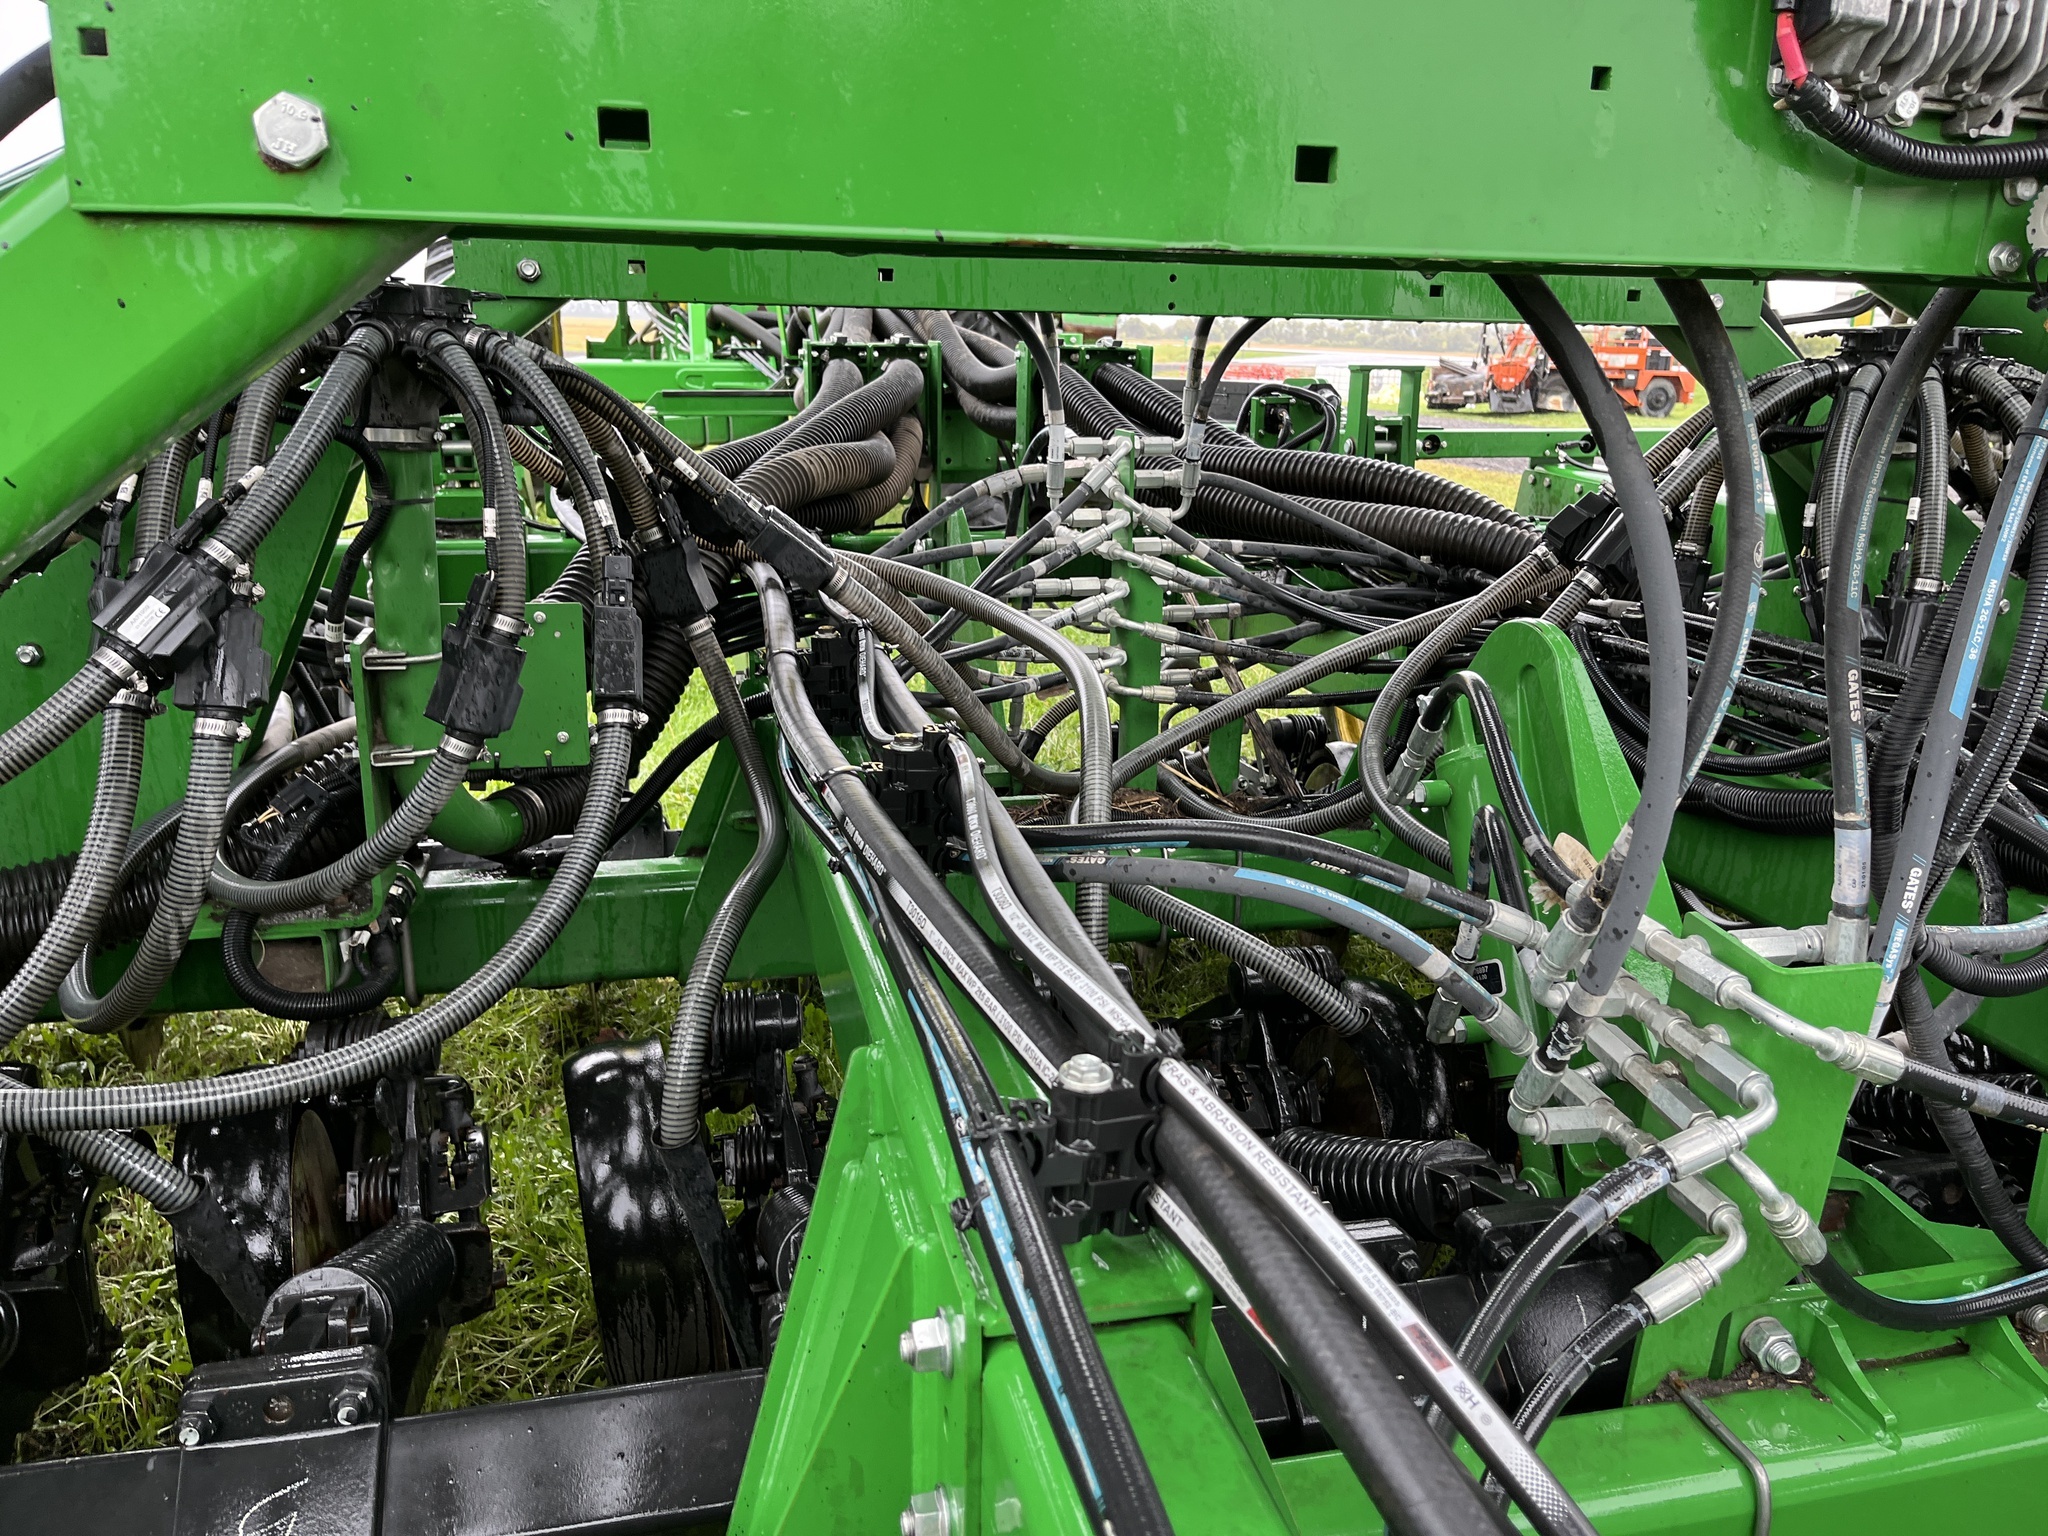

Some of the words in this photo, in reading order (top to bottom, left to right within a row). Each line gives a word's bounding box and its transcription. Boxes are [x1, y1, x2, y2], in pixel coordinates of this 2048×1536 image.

[1751, 443, 1761, 472] 4000
[1872, 456, 1886, 484] Flame
[1860, 486, 1877, 531] Resistant
[1855, 532, 1866, 562] MSHA
[1850, 564, 1861, 599] 2G-11C
[1983, 578, 1998, 607] MSHA
[1968, 608, 1991, 660] 2G-11C/36
[1848, 669, 1861, 722] GATES
[1069, 856, 1106, 865] GATES
[1310, 860, 1348, 876] GATES
[1902, 867, 1922, 910] GATES
[956, 962, 968, 980] MAX
[966, 974, 978, 988] WP
[983, 996, 998, 1014] BAR
[1011, 1029, 1022, 1046] PSI
[1024, 1043, 1044, 1070] MSHA
[1107, 1006, 1132, 1030] MSHA
[1161, 1061, 1189, 1088] FRAS
[1187, 1084, 1200, 1097] &
[1198, 1096, 1257, 1152] ABRASION
[1252, 1150, 1322, 1218] RESISTANT
